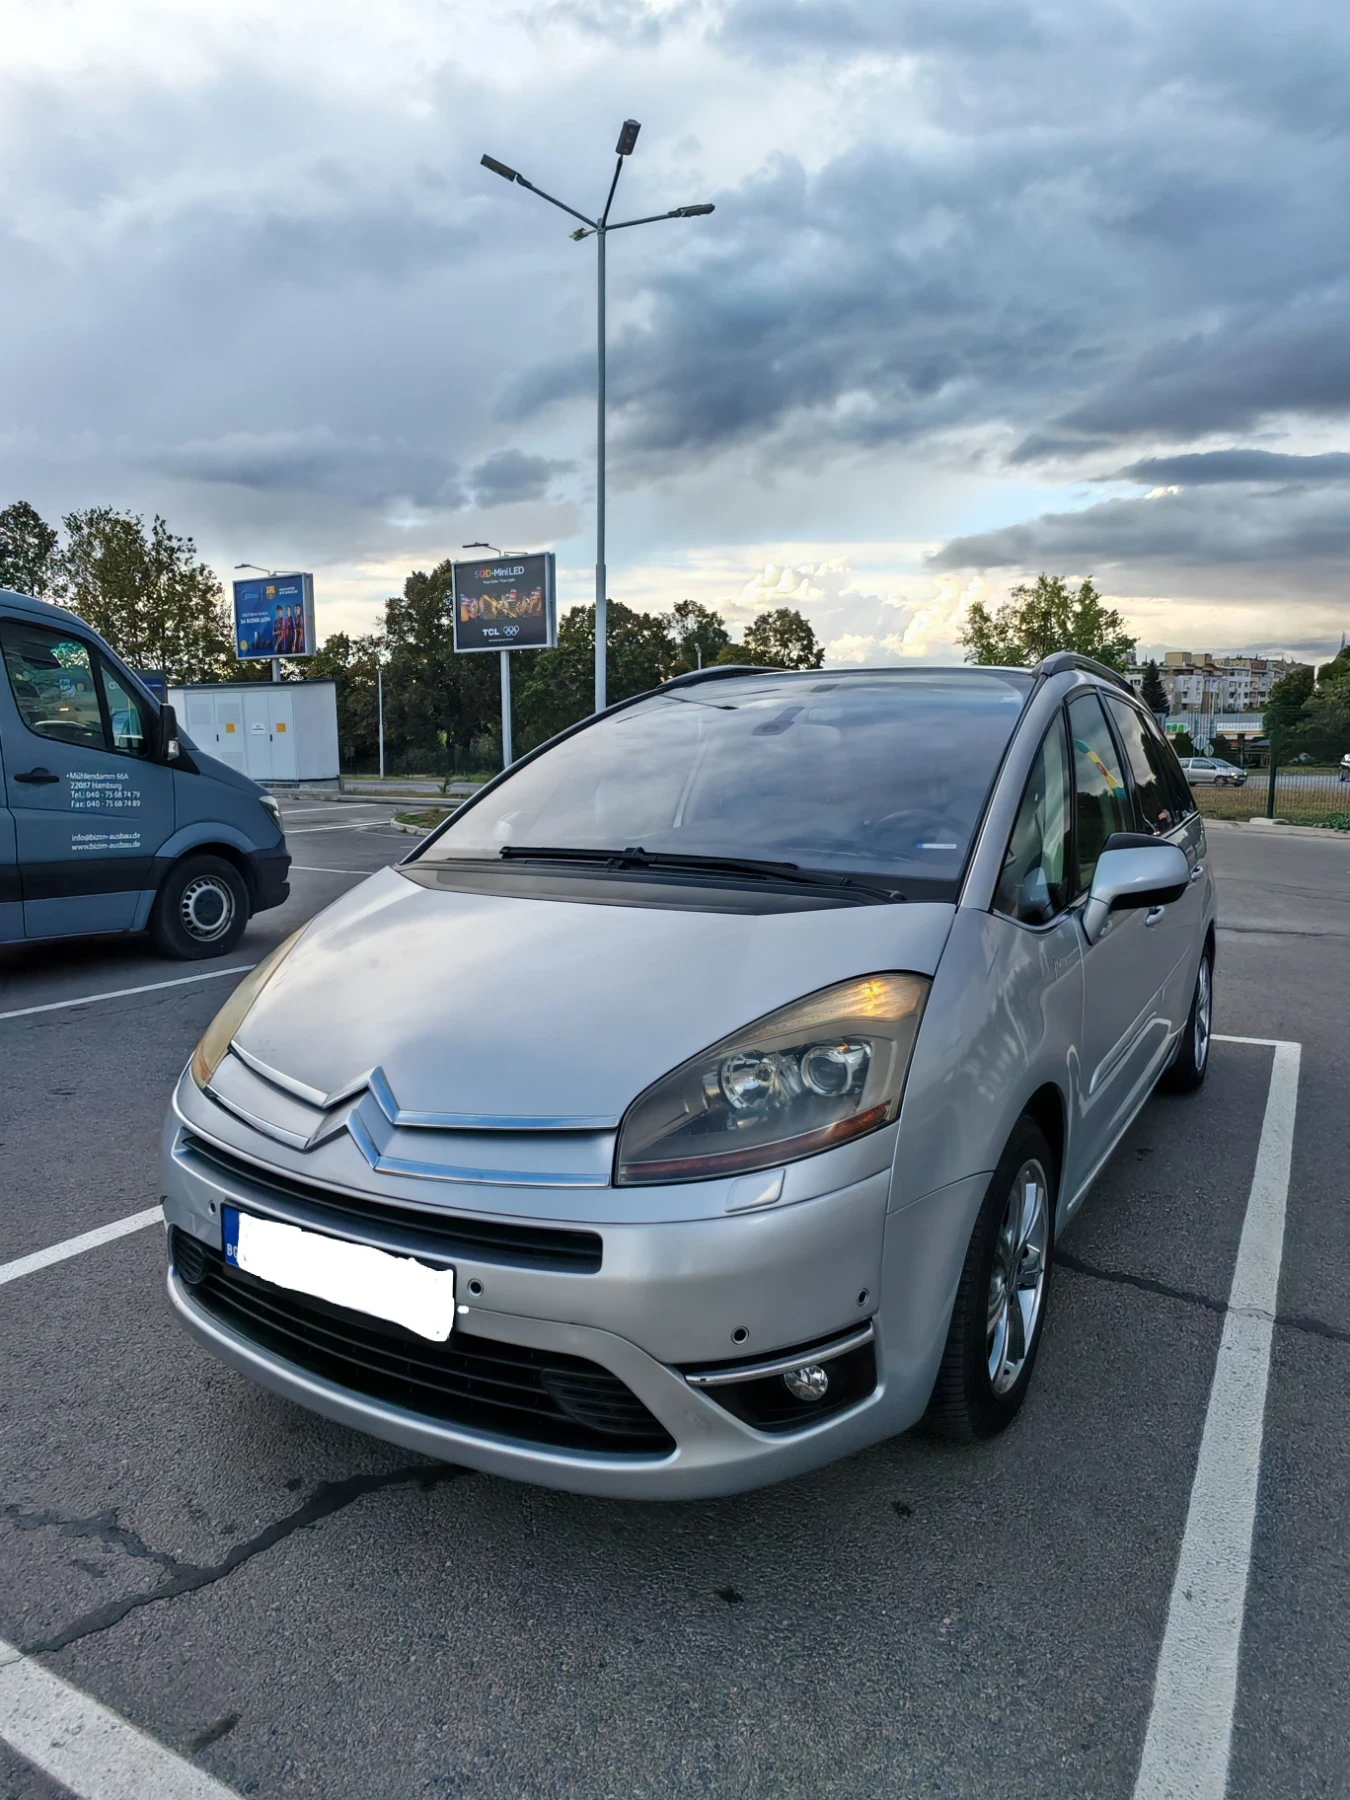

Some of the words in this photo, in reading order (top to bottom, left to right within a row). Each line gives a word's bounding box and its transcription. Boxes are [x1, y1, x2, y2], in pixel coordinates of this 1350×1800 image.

[483, 628, 499, 636] TCL
[92, 782, 122, 790] Hamburg
[86, 800, 100, 808] 040
